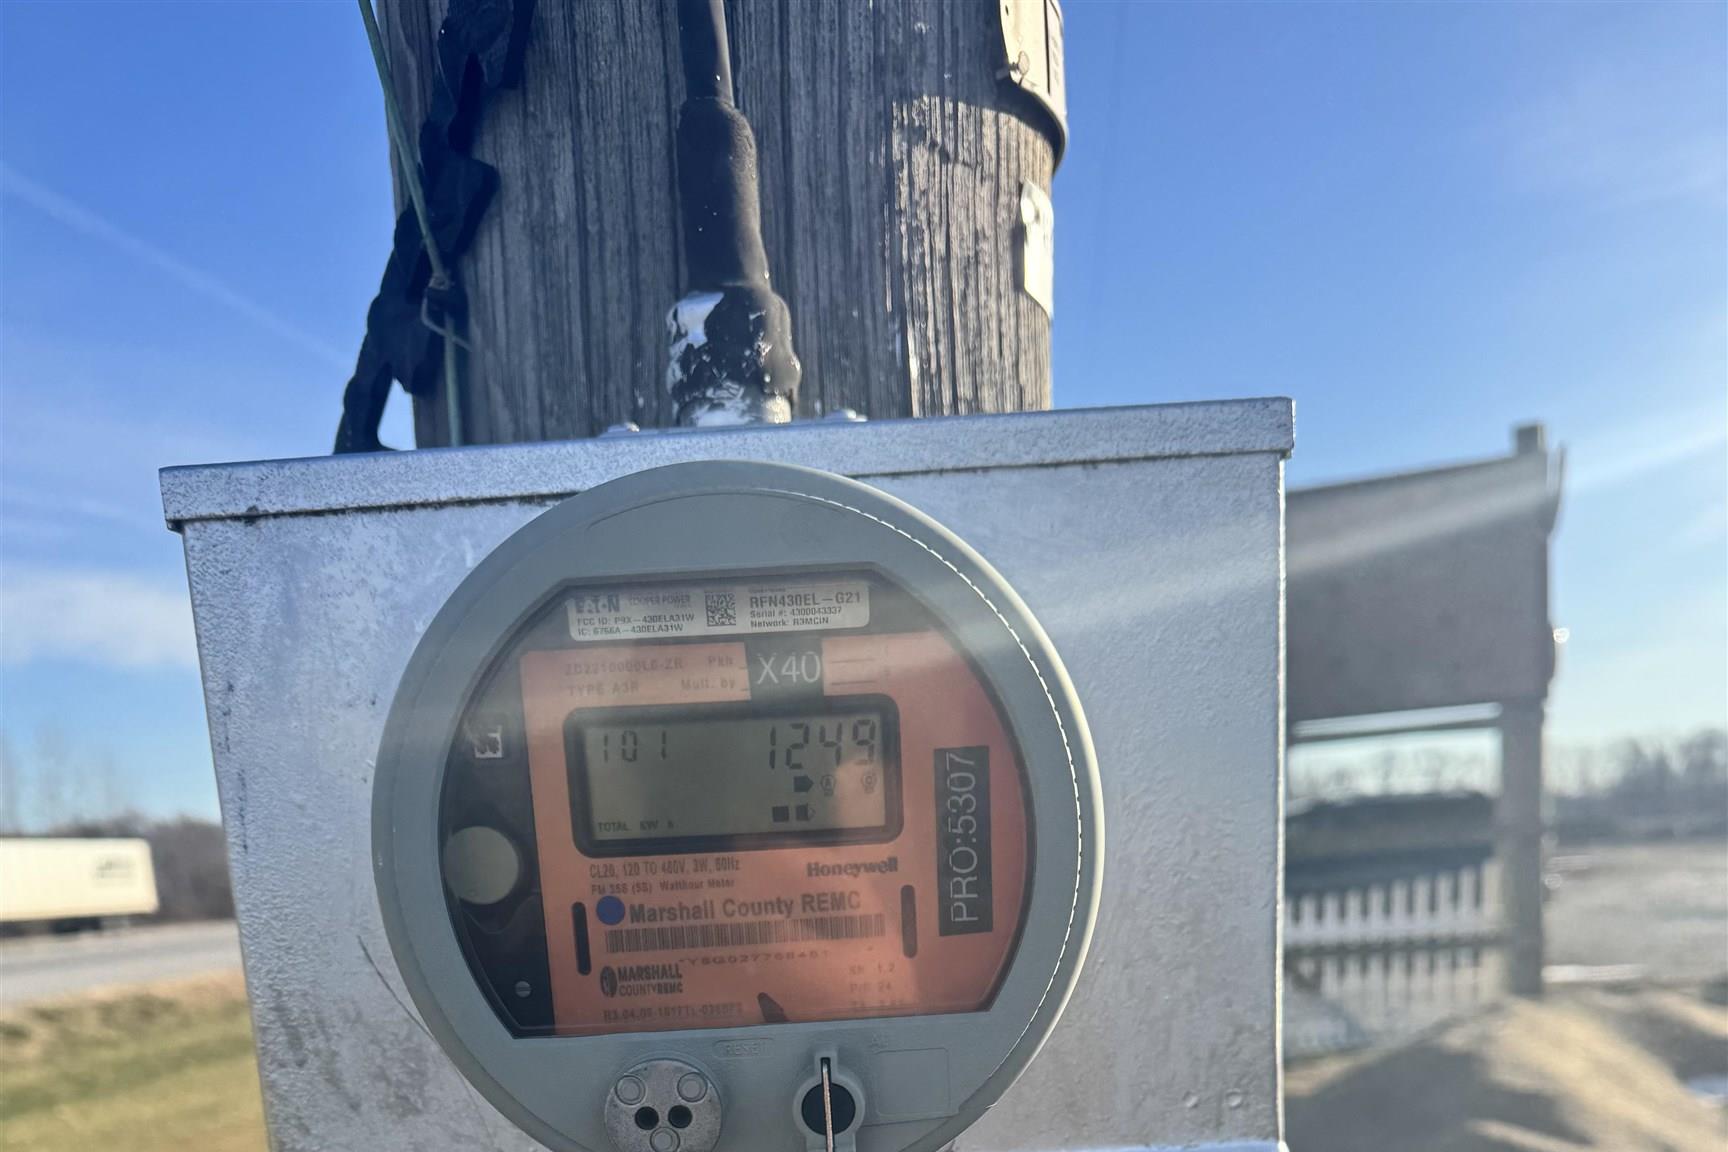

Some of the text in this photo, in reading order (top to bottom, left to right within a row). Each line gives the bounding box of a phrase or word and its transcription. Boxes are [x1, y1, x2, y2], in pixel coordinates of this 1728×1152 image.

[577, 617, 595, 626] FCC
[750, 608, 776, 618] Serial
[756, 650, 821, 684] X40
[603, 719, 876, 769] 101 1249
[598, 821, 631, 833] TOTAL
[946, 751, 979, 922] PRO:5307
[623, 862, 640, 877] 120
[644, 862, 657, 876] TO
[807, 855, 898, 878] Honeywell
[629, 890, 861, 924] Marshall County REMC
[618, 962, 683, 982] MARSHALL
